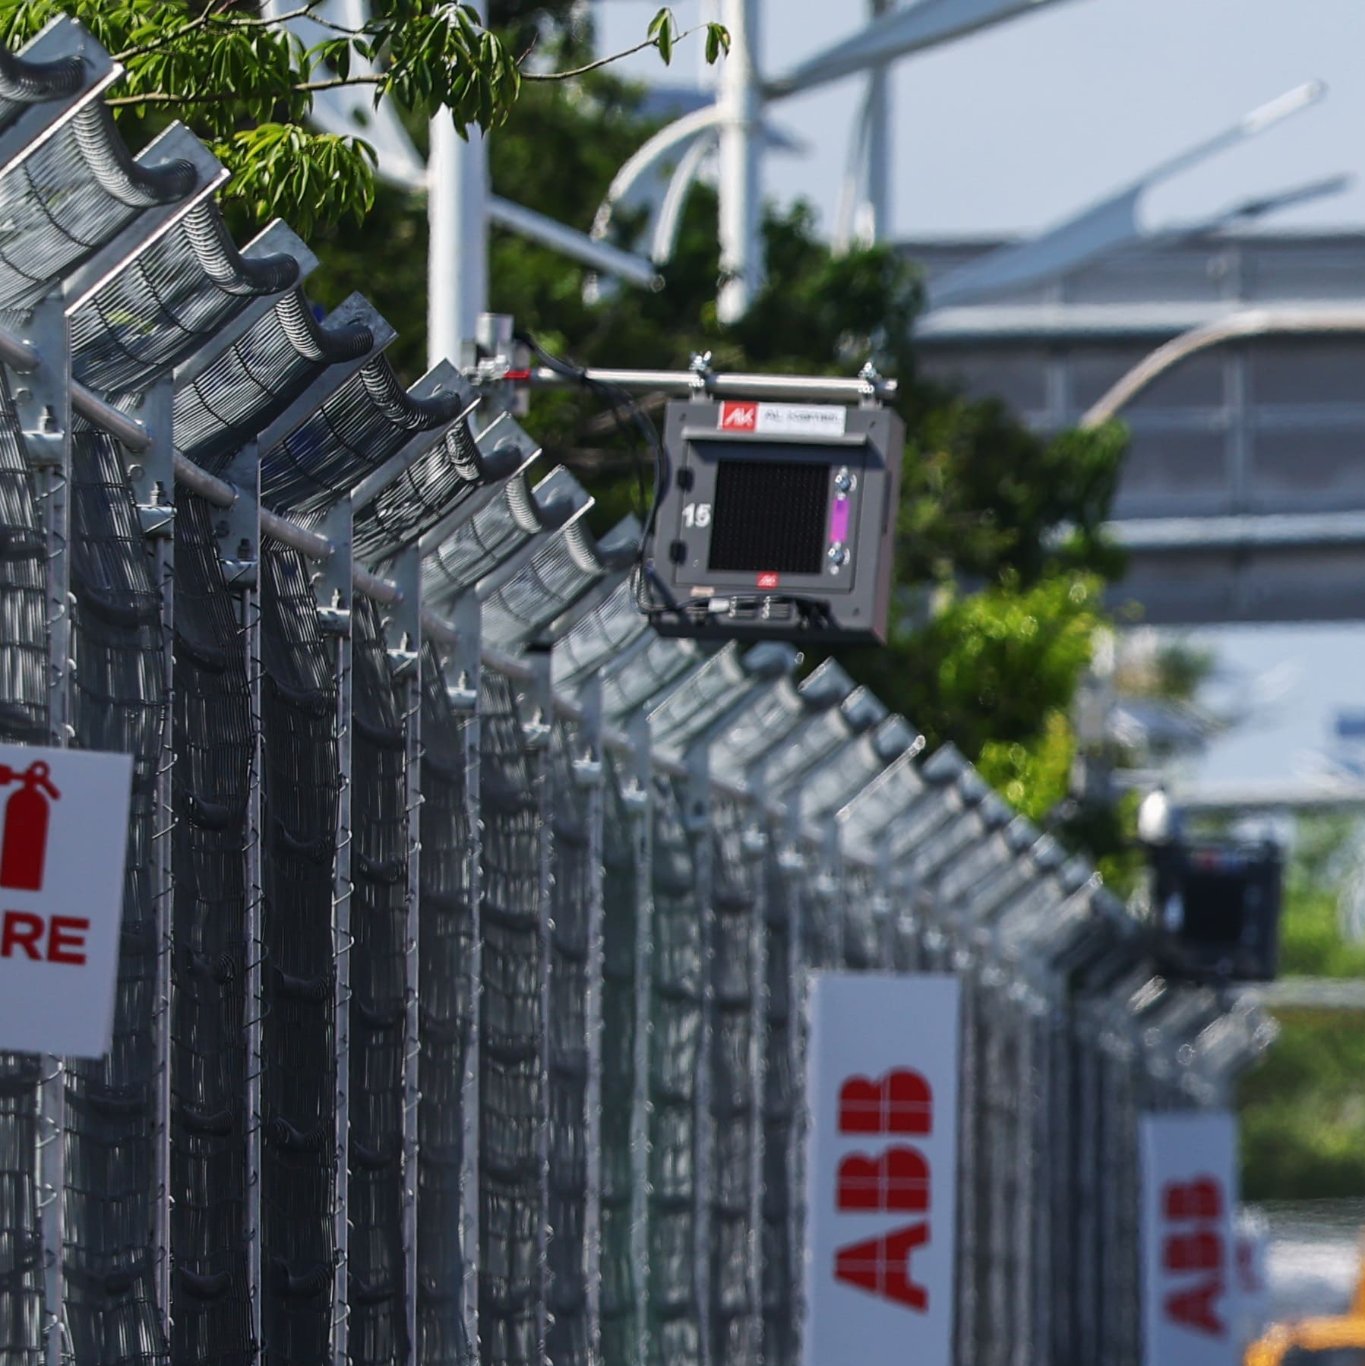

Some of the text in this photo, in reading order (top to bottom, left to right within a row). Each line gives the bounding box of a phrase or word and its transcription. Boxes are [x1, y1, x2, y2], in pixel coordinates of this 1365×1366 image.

[0, 909, 90, 966] RE
[833, 1066, 933, 1316] ABB
[1159, 1173, 1229, 1339] ABB
